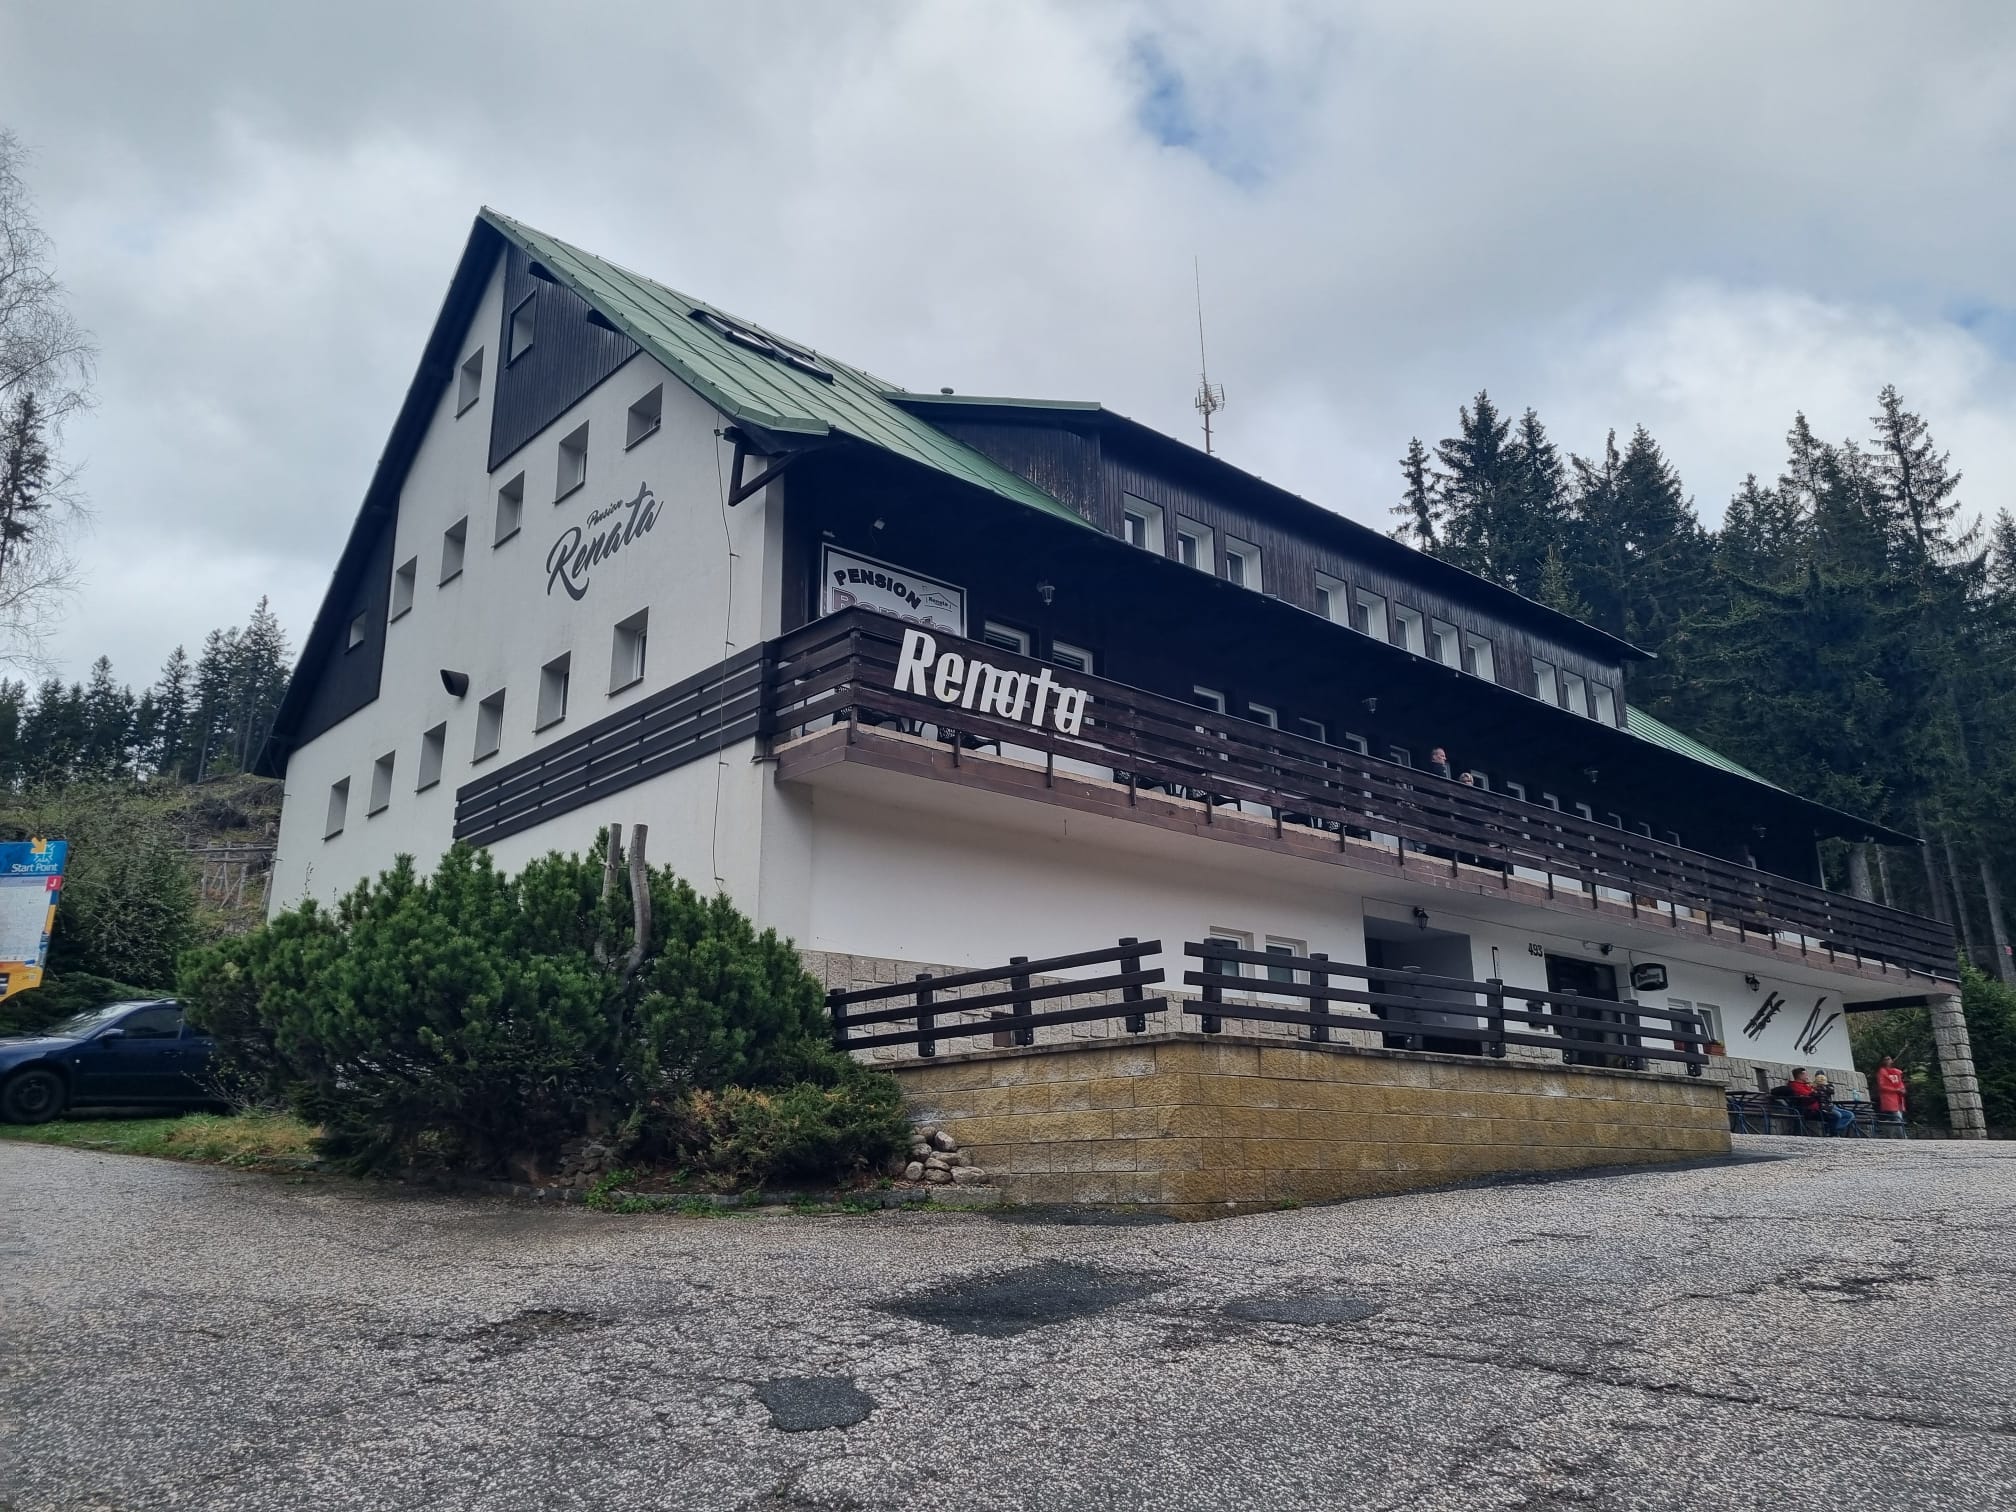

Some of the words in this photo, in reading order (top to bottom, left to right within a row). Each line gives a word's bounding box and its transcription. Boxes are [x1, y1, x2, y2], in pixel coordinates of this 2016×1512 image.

[586, 499, 624, 530] Pension
[545, 481, 664, 601] Renata
[833, 568, 922, 610] PENSION
[893, 628, 1088, 737] Renata
[11, 863, 35, 873] Start
[35, 863, 58, 872] Point
[50, 878, 57, 888] J
[1528, 943, 1543, 957] 493
